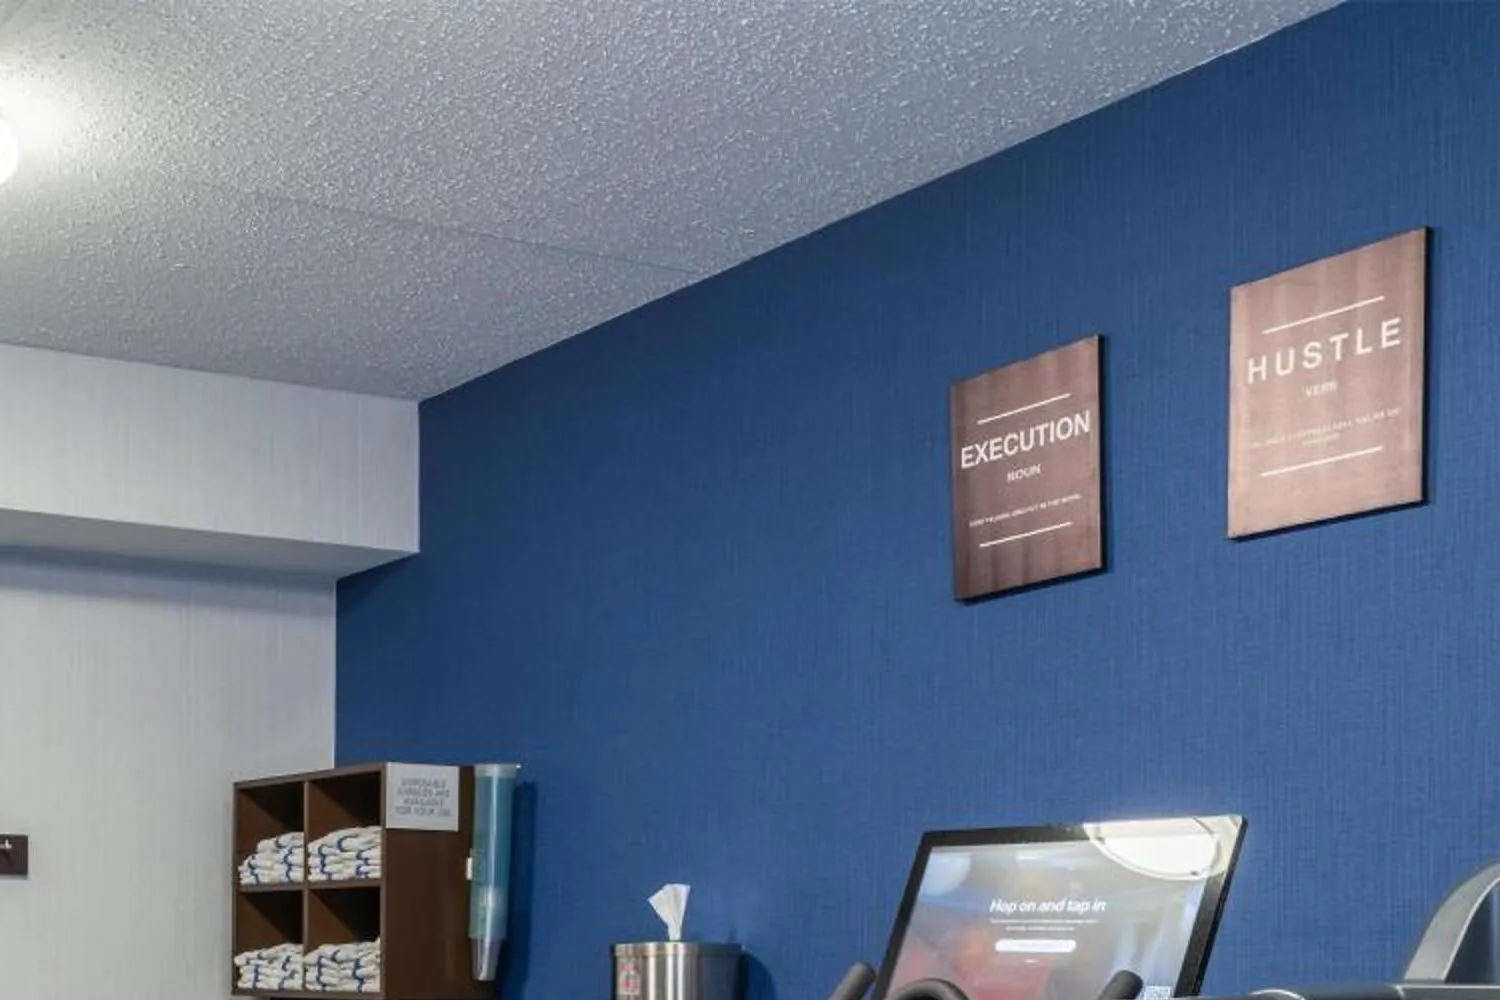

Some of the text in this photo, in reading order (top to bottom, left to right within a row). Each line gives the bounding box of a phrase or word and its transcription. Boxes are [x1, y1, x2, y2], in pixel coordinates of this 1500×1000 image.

[1247, 317, 1401, 385] HUSTLE
[961, 410, 1090, 469] EXECUTION
[1007, 464, 1041, 482] NOUN
[989, 898, 1107, 916] Hop on and tap in
